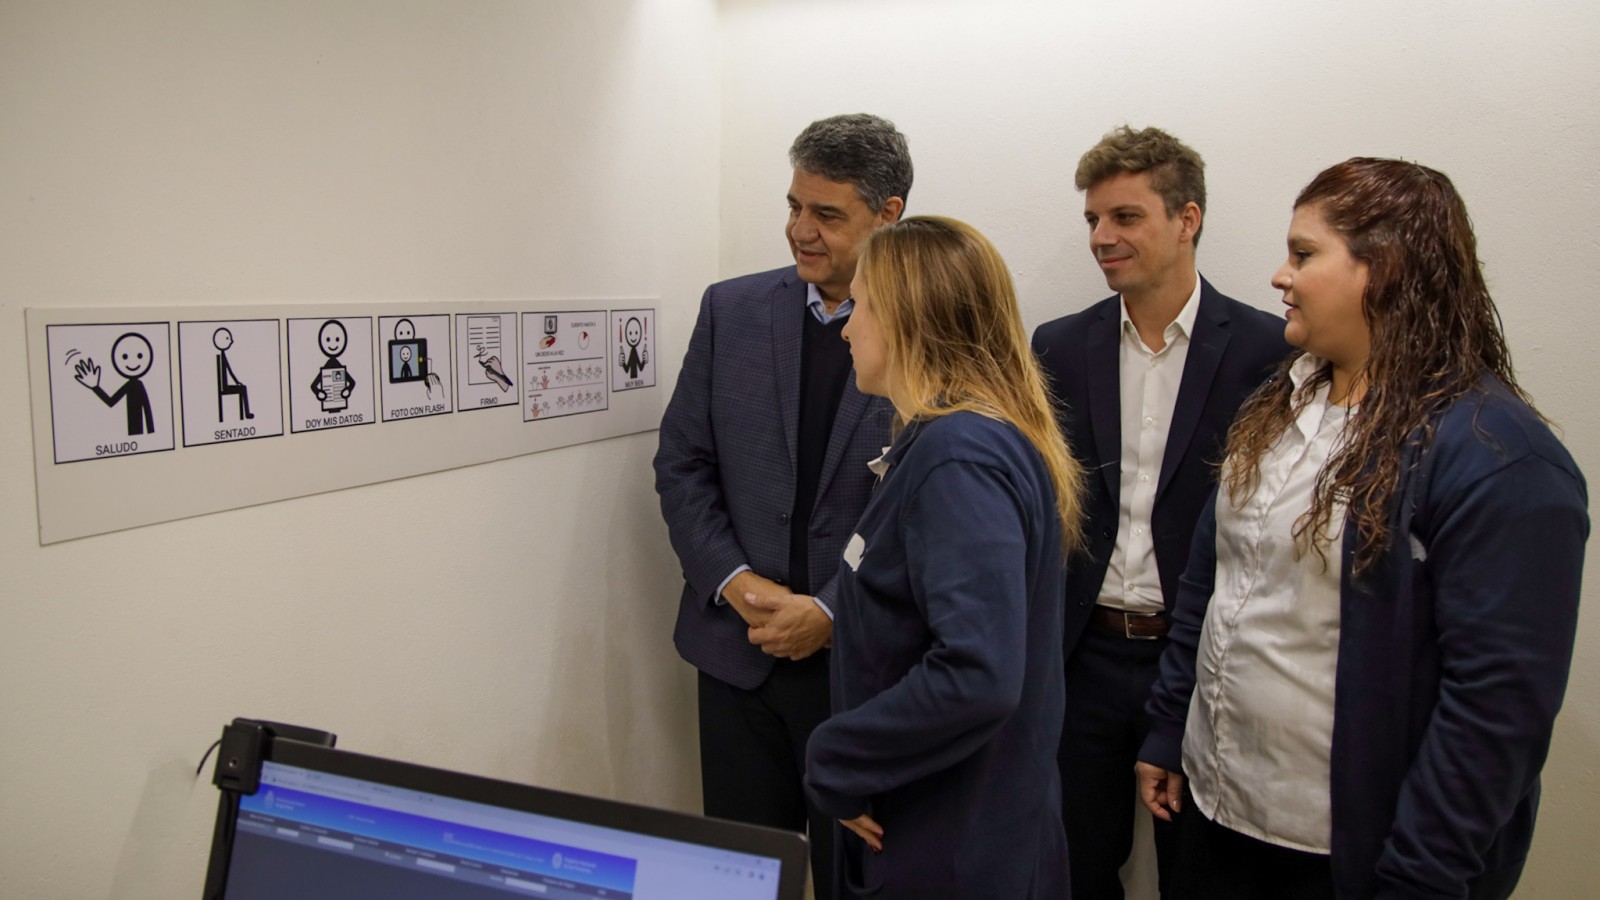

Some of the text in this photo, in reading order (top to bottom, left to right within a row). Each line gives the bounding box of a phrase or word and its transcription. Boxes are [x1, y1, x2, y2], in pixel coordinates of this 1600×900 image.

[480, 397, 498, 406] FIRMO
[391, 404, 444, 418] FOTO CON FLASH
[306, 414, 363, 428] DOY MIS DATOS
[214, 427, 256, 440] SENTADO
[96, 441, 138, 455] SALUDO
